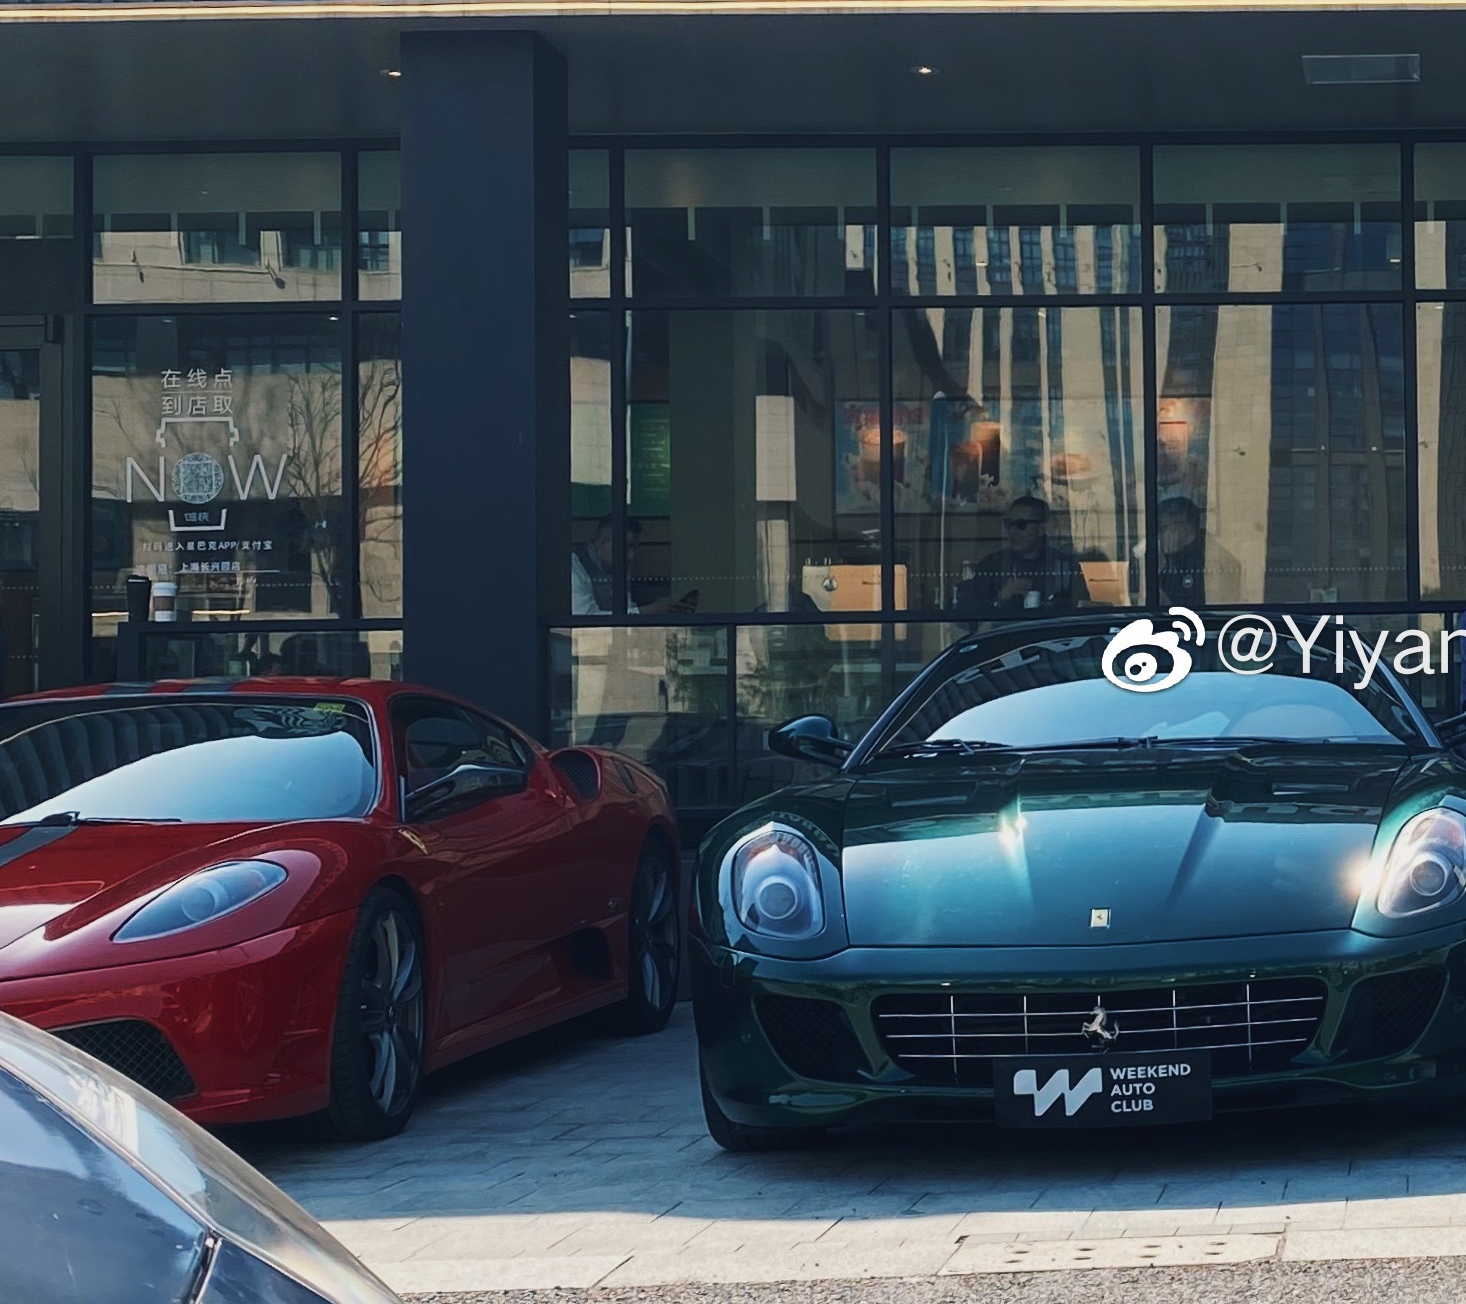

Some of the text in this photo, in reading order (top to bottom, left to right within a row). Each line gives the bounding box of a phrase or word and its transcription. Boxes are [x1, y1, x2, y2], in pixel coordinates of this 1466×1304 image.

[160, 368, 233, 389] 在线点
[160, 395, 233, 416] 到店取
[1109, 1063, 1192, 1080] WEEKEND
[1110, 1082, 1156, 1097] AUTO
[1110, 1099, 1154, 1113] CLUB
